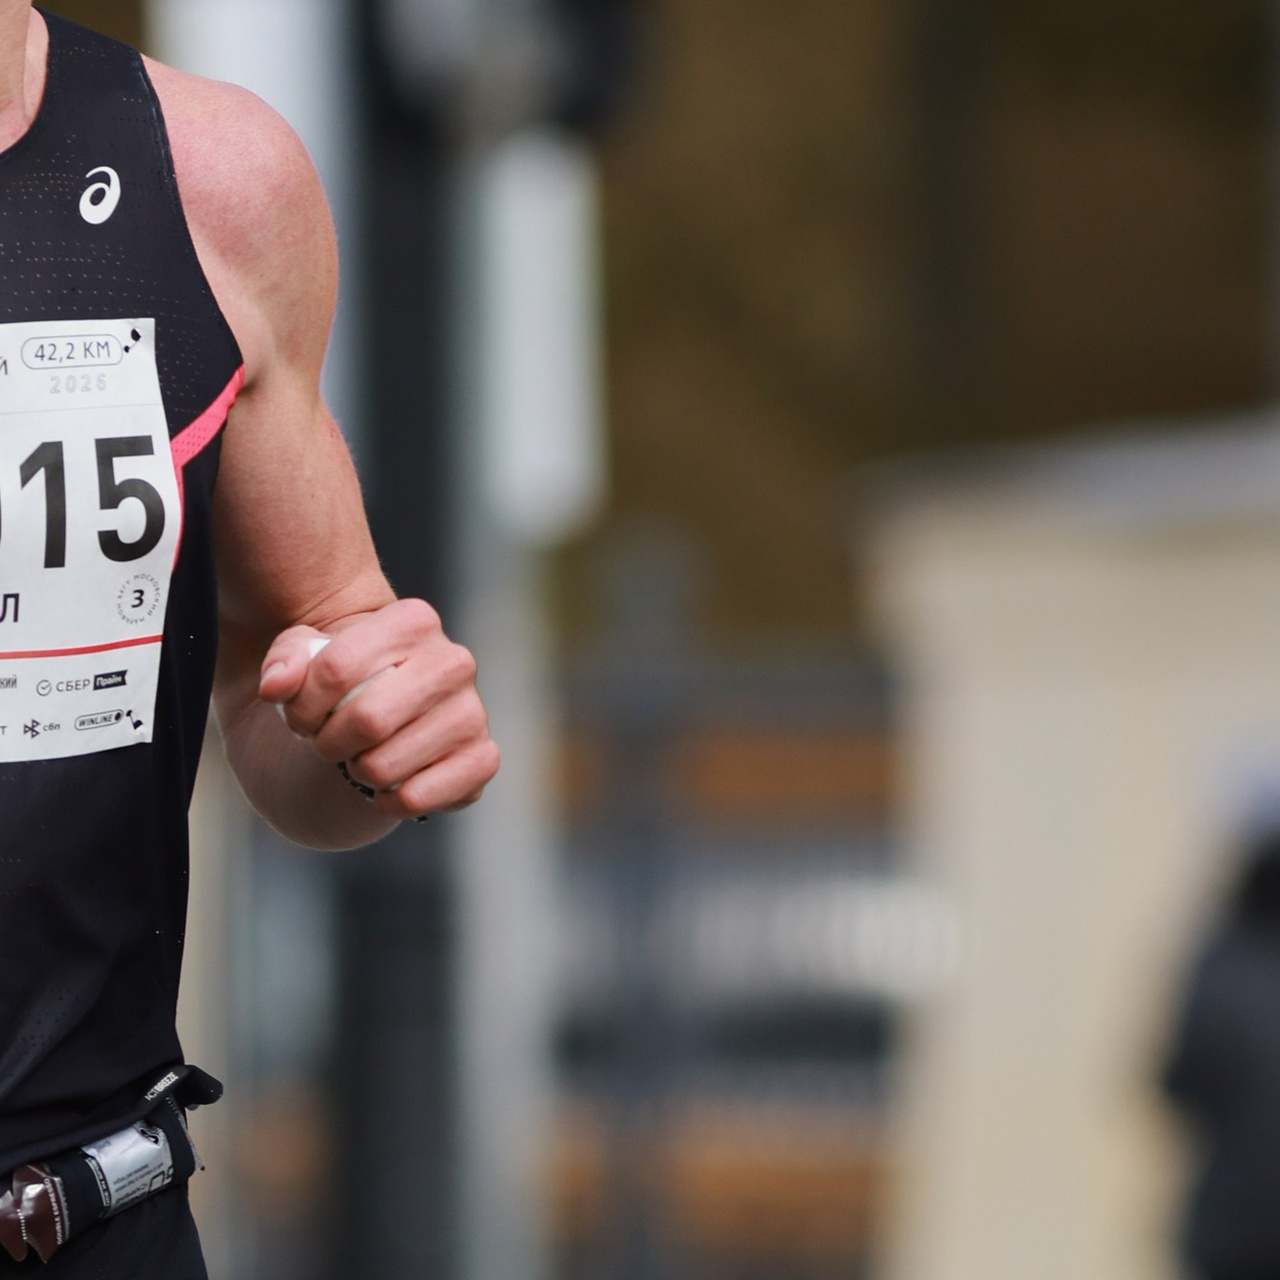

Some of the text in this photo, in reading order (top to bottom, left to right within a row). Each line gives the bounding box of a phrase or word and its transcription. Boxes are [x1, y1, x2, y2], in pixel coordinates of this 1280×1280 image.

[34, 342, 75, 363] 42,2
[131, 589, 145, 609] 3
[56, 678, 91, 692] СБЕР
[42, 722, 61, 732] сбп
[78, 713, 114, 728] WINLINE
